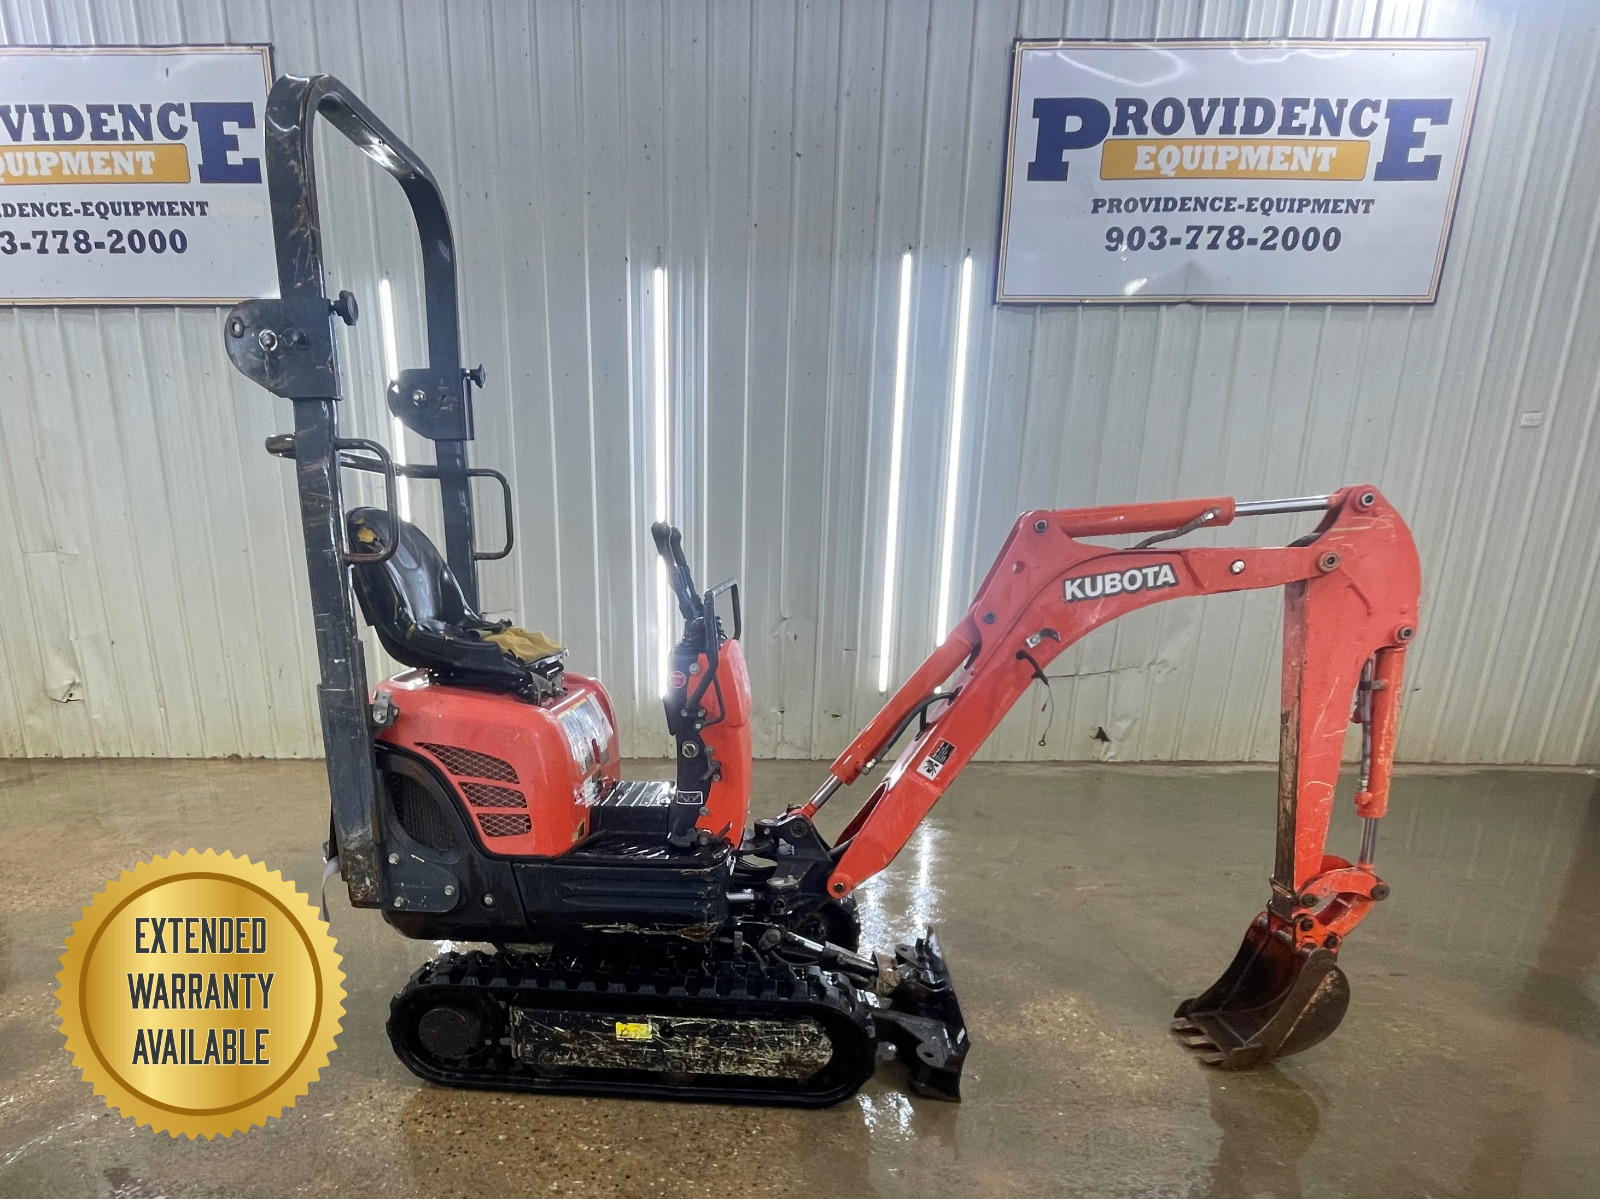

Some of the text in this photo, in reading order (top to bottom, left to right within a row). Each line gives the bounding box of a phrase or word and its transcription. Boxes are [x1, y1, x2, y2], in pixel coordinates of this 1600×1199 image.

[1027, 97, 1453, 182] PROVIDENCE
[0, 150, 156, 183] UIPMENT
[1134, 145, 1337, 177] EQUIPMENT
[0, 200, 209, 221] DENCE-EQUIPMENT
[1091, 196, 1375, 216] PROVIDENCE-EQUIPMENT
[1105, 225, 1342, 252] 903-778-2000
[1064, 564, 1176, 601] KUBOTA
